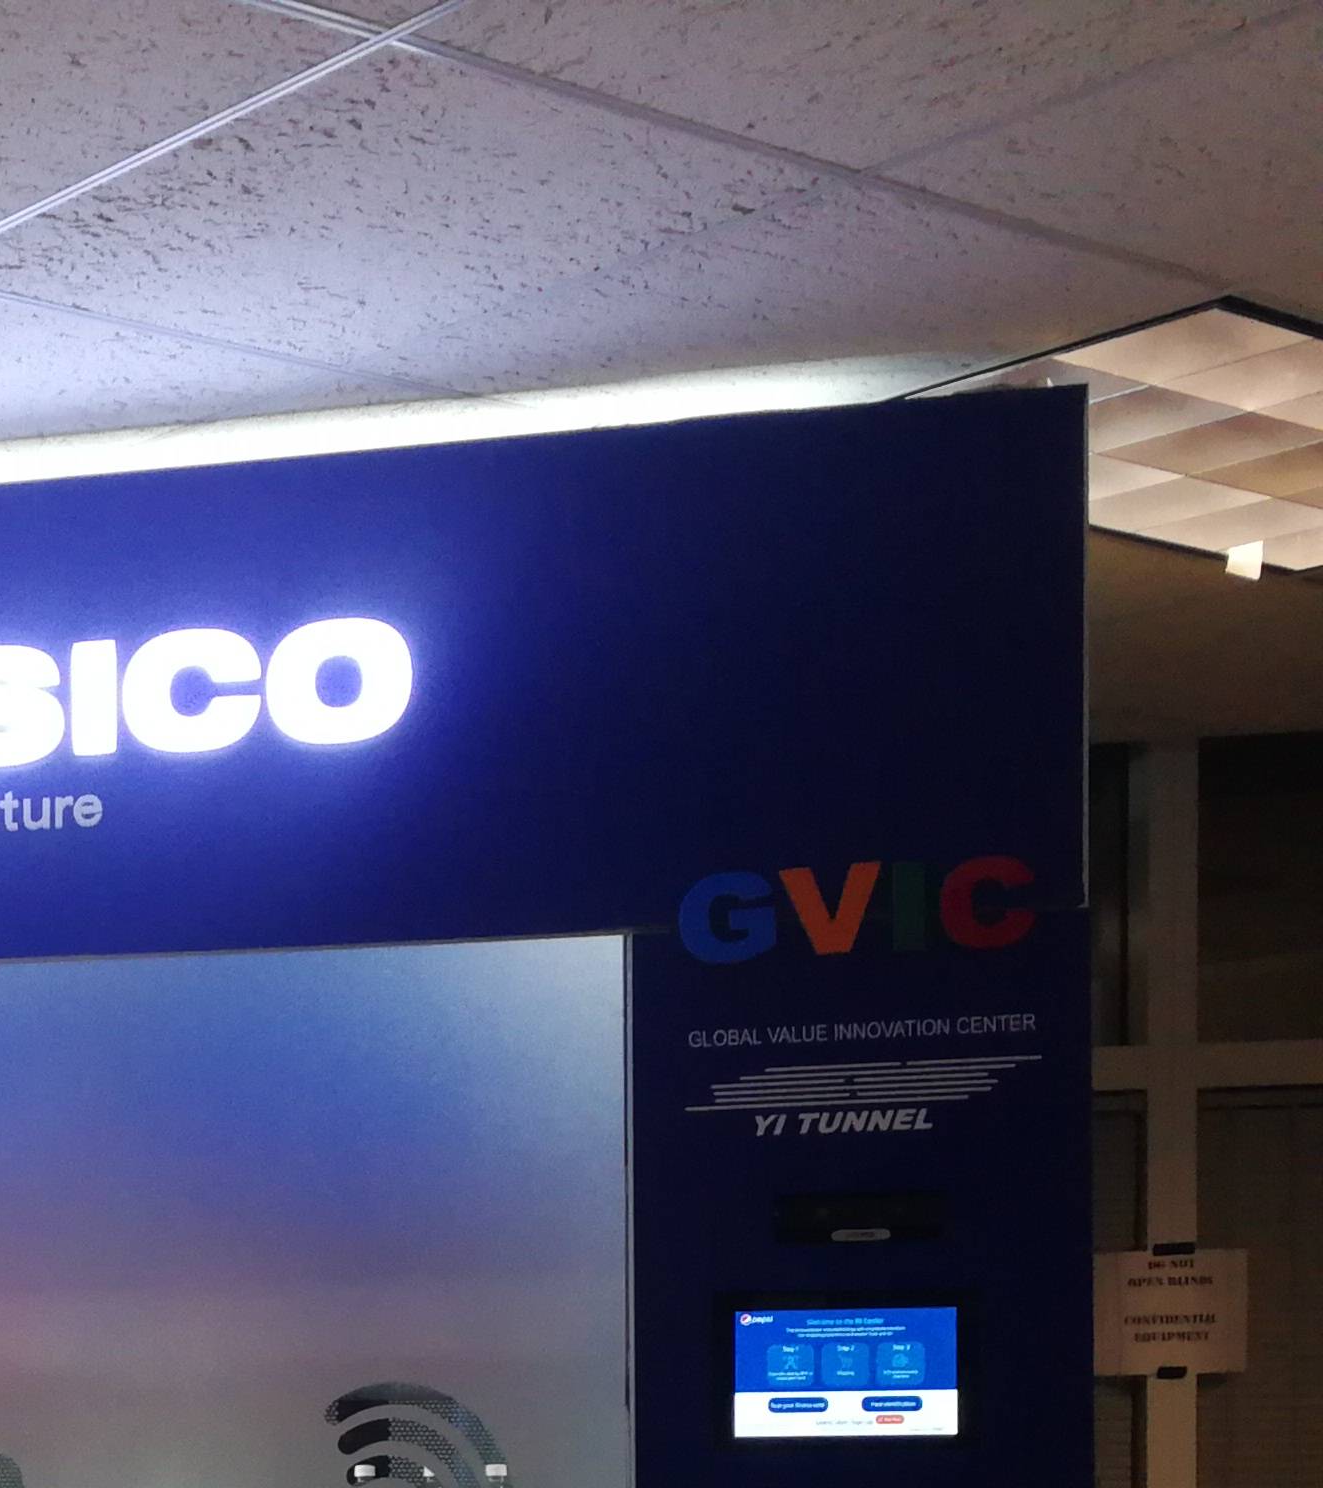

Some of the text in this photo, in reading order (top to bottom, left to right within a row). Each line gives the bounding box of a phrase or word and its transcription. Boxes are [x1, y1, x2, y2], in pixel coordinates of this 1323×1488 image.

[678, 855, 1036, 965] GVIC
[688, 1013, 1036, 1048] GLOBAL VALUE INNOVATION CENTER
[755, 1107, 933, 1137] YI TUNNEL
